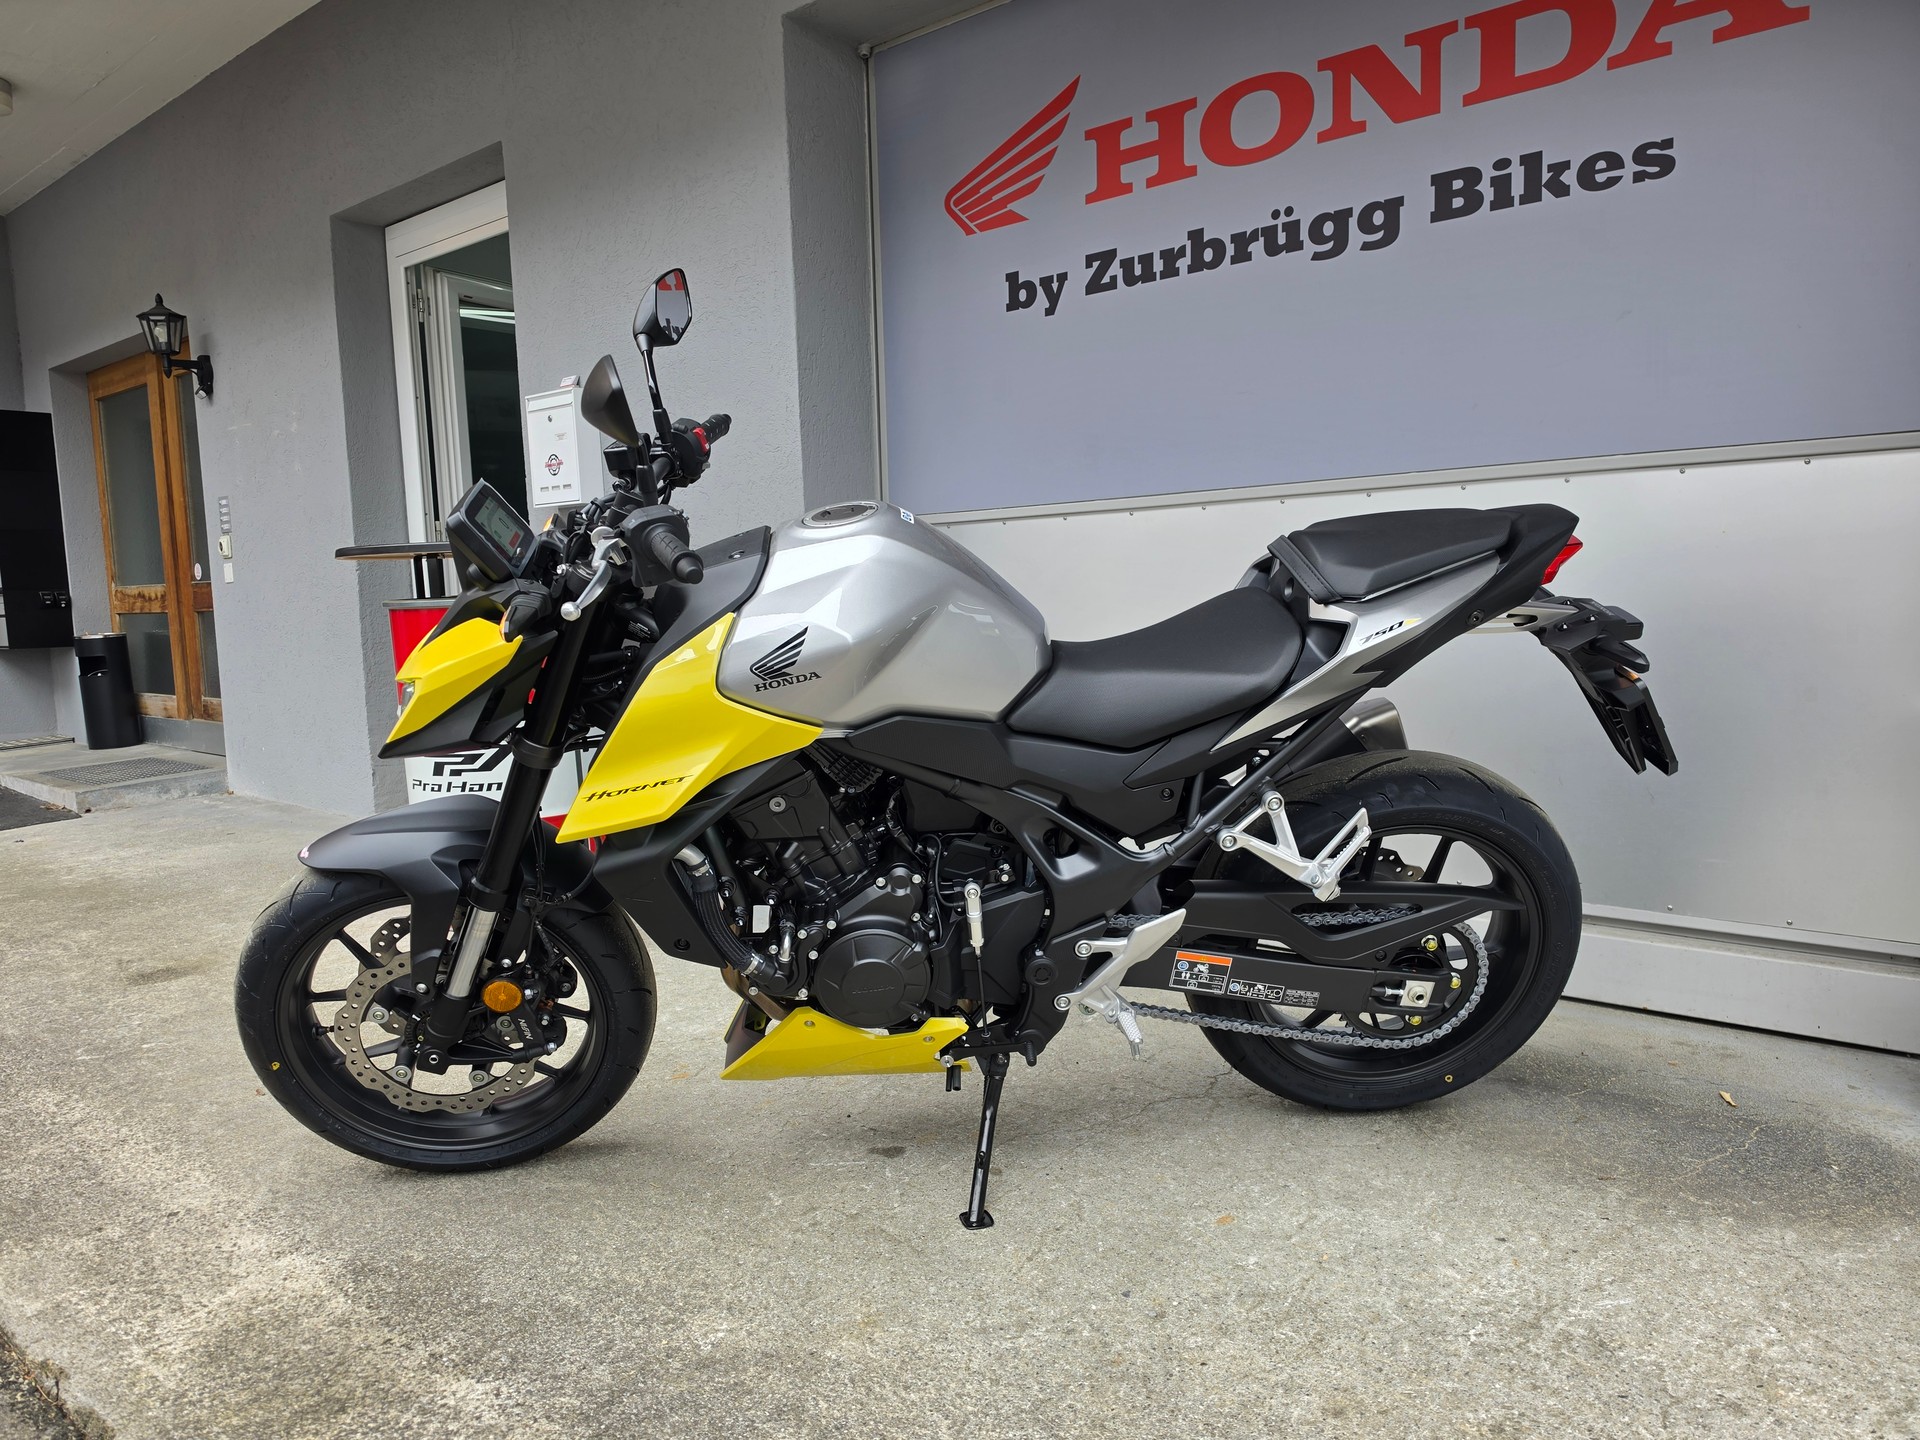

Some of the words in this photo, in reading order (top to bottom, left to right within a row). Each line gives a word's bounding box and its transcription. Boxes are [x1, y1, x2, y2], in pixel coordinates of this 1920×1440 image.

[1006, 271, 1067, 316] by
[1086, 196, 1404, 295] Zurbrügg
[1431, 137, 1676, 223] Bikes
[1360, 620, 1404, 645] 750
[753, 671, 822, 693] HONDA
[446, 781, 503, 793] Hon
[582, 775, 694, 802] HORNET
